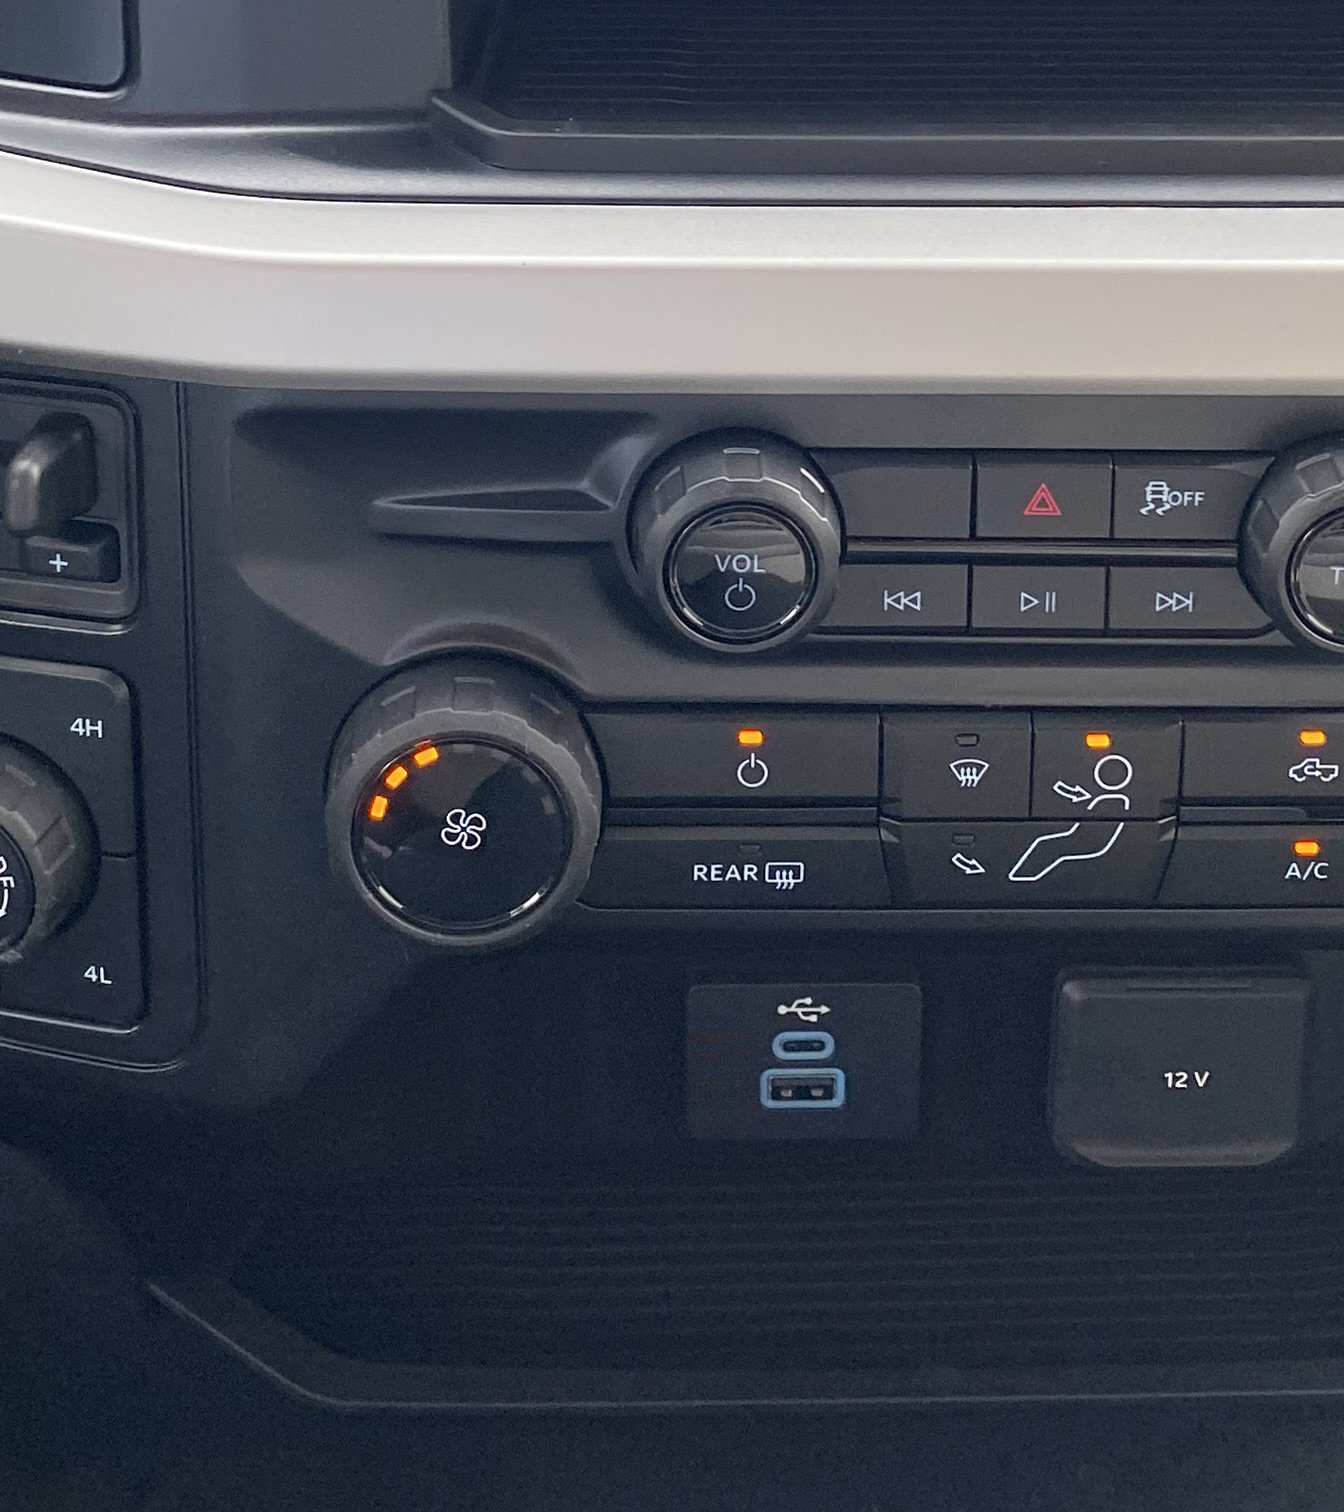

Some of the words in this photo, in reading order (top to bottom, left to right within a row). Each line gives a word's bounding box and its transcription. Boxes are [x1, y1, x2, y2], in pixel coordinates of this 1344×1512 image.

[1168, 491, 1205, 506] OFF
[715, 554, 766, 572] VOL
[70, 718, 103, 738] 4H
[693, 863, 758, 884] REAR
[1284, 862, 1328, 881] A/C
[83, 965, 112, 984] 4L
[1163, 1071, 1189, 1088] 12
[1193, 1071, 1210, 1088] V
